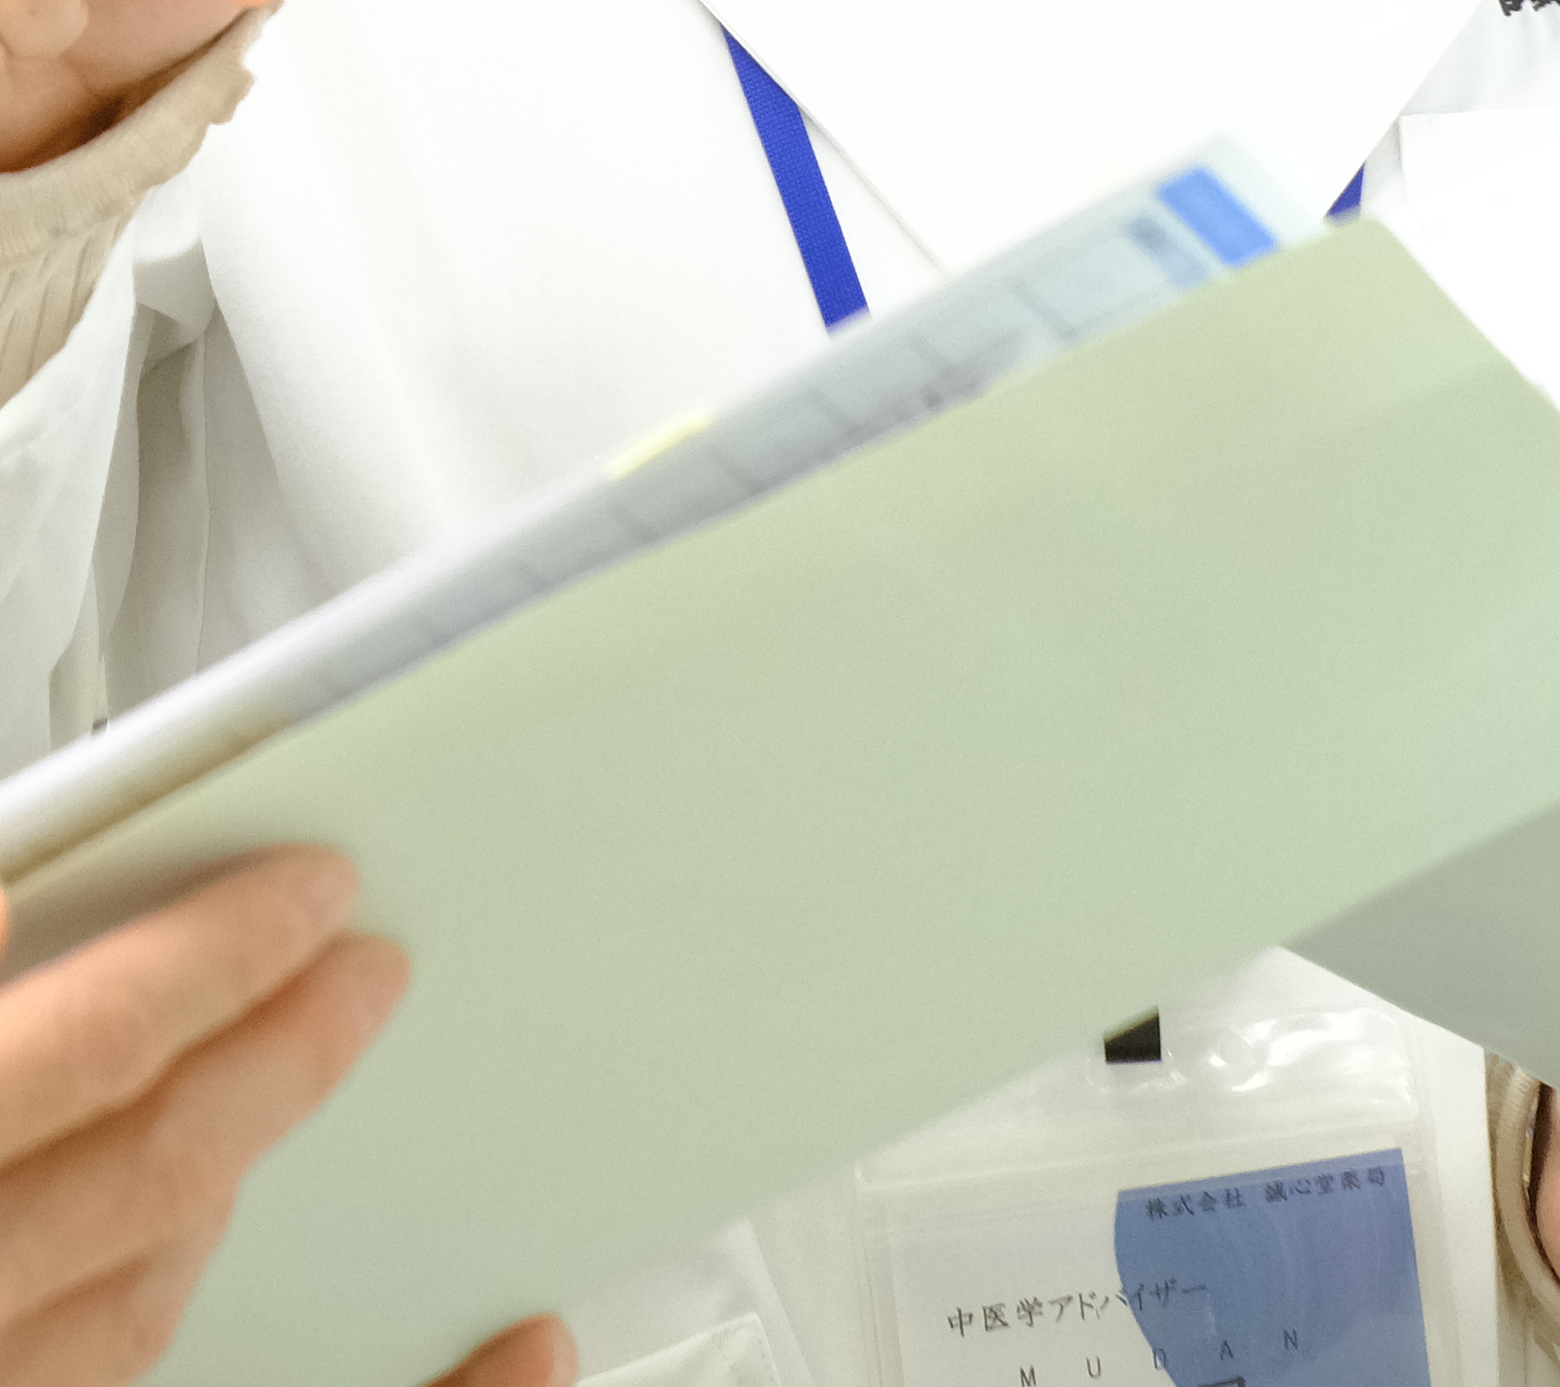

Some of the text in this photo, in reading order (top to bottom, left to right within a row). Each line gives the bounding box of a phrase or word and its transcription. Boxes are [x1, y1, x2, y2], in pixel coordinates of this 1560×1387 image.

[1145, 1186, 1244, 1222] 株式会社
[946, 1277, 1209, 1338] 中医学アドバイザー
